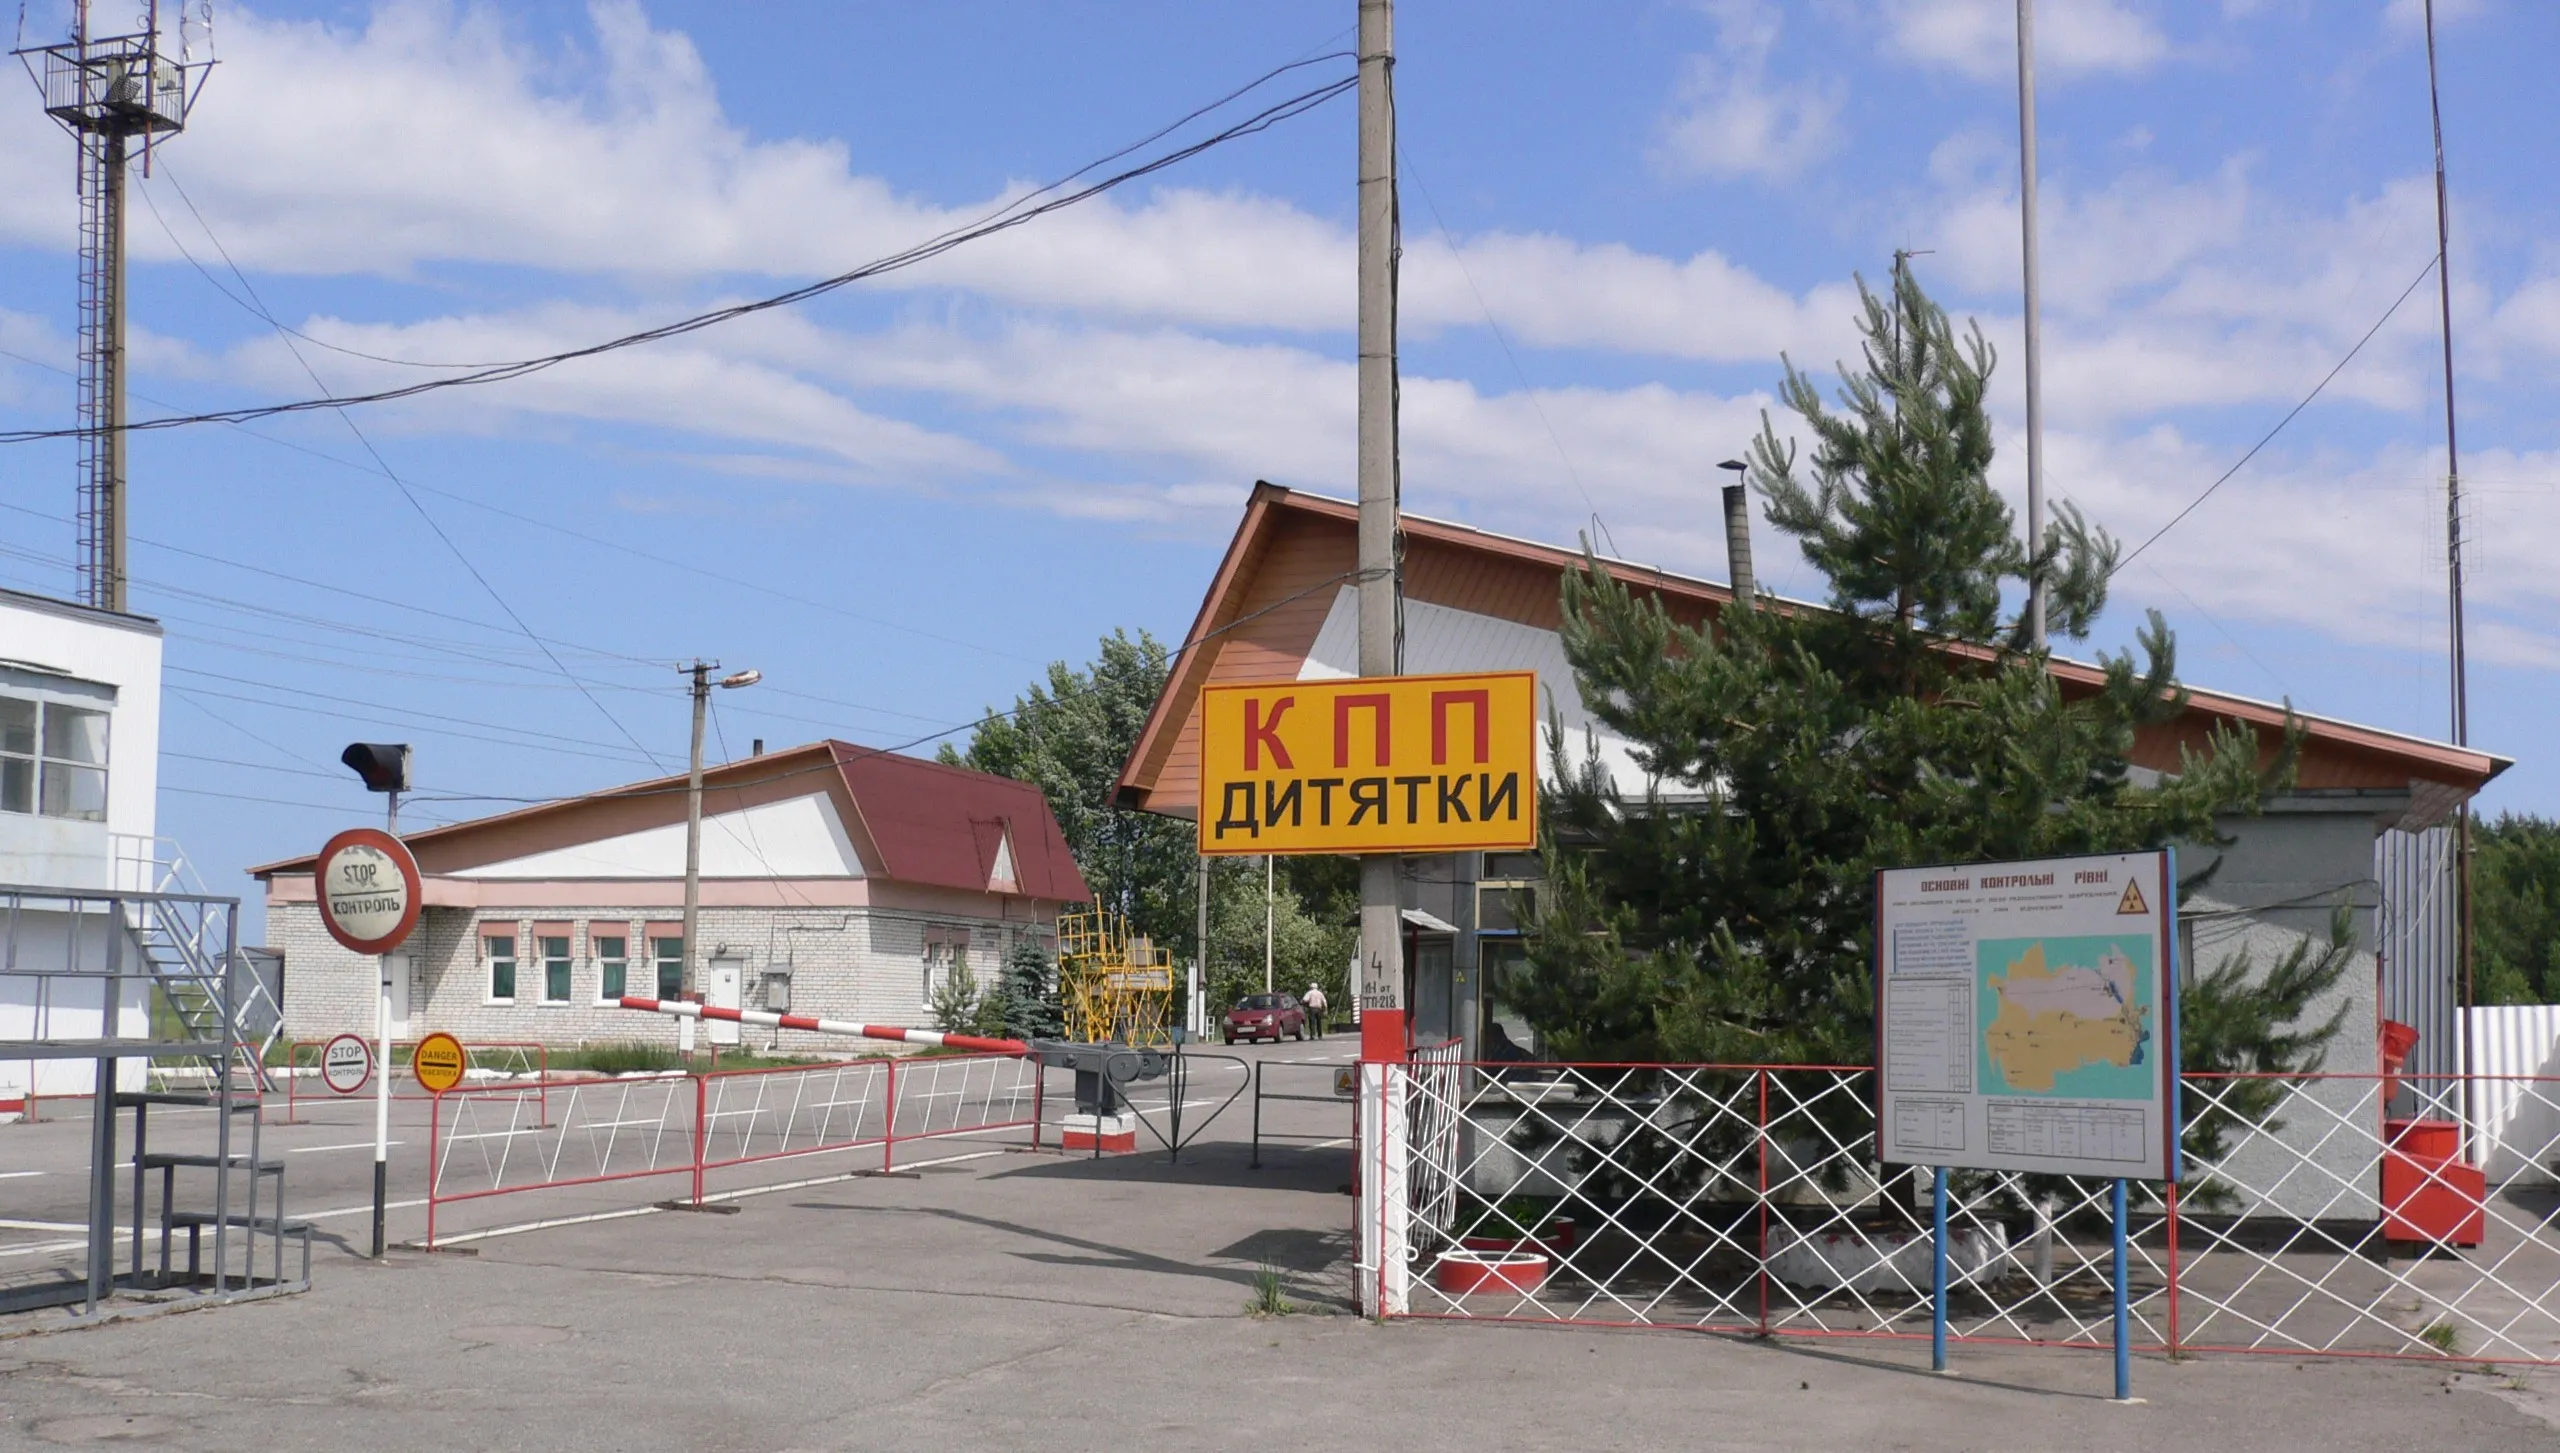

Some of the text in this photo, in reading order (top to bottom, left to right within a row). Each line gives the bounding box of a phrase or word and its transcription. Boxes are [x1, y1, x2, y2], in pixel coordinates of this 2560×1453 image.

[1215, 772, 1518, 839] ДИТЯТКИ
[343, 863, 377, 883] STOP
[333, 897, 400, 915] КОНТРОЛЬ
[1371, 951, 1383, 979] 4
[331, 1046, 361, 1059] STOP
[421, 1050, 458, 1061] DANGER
